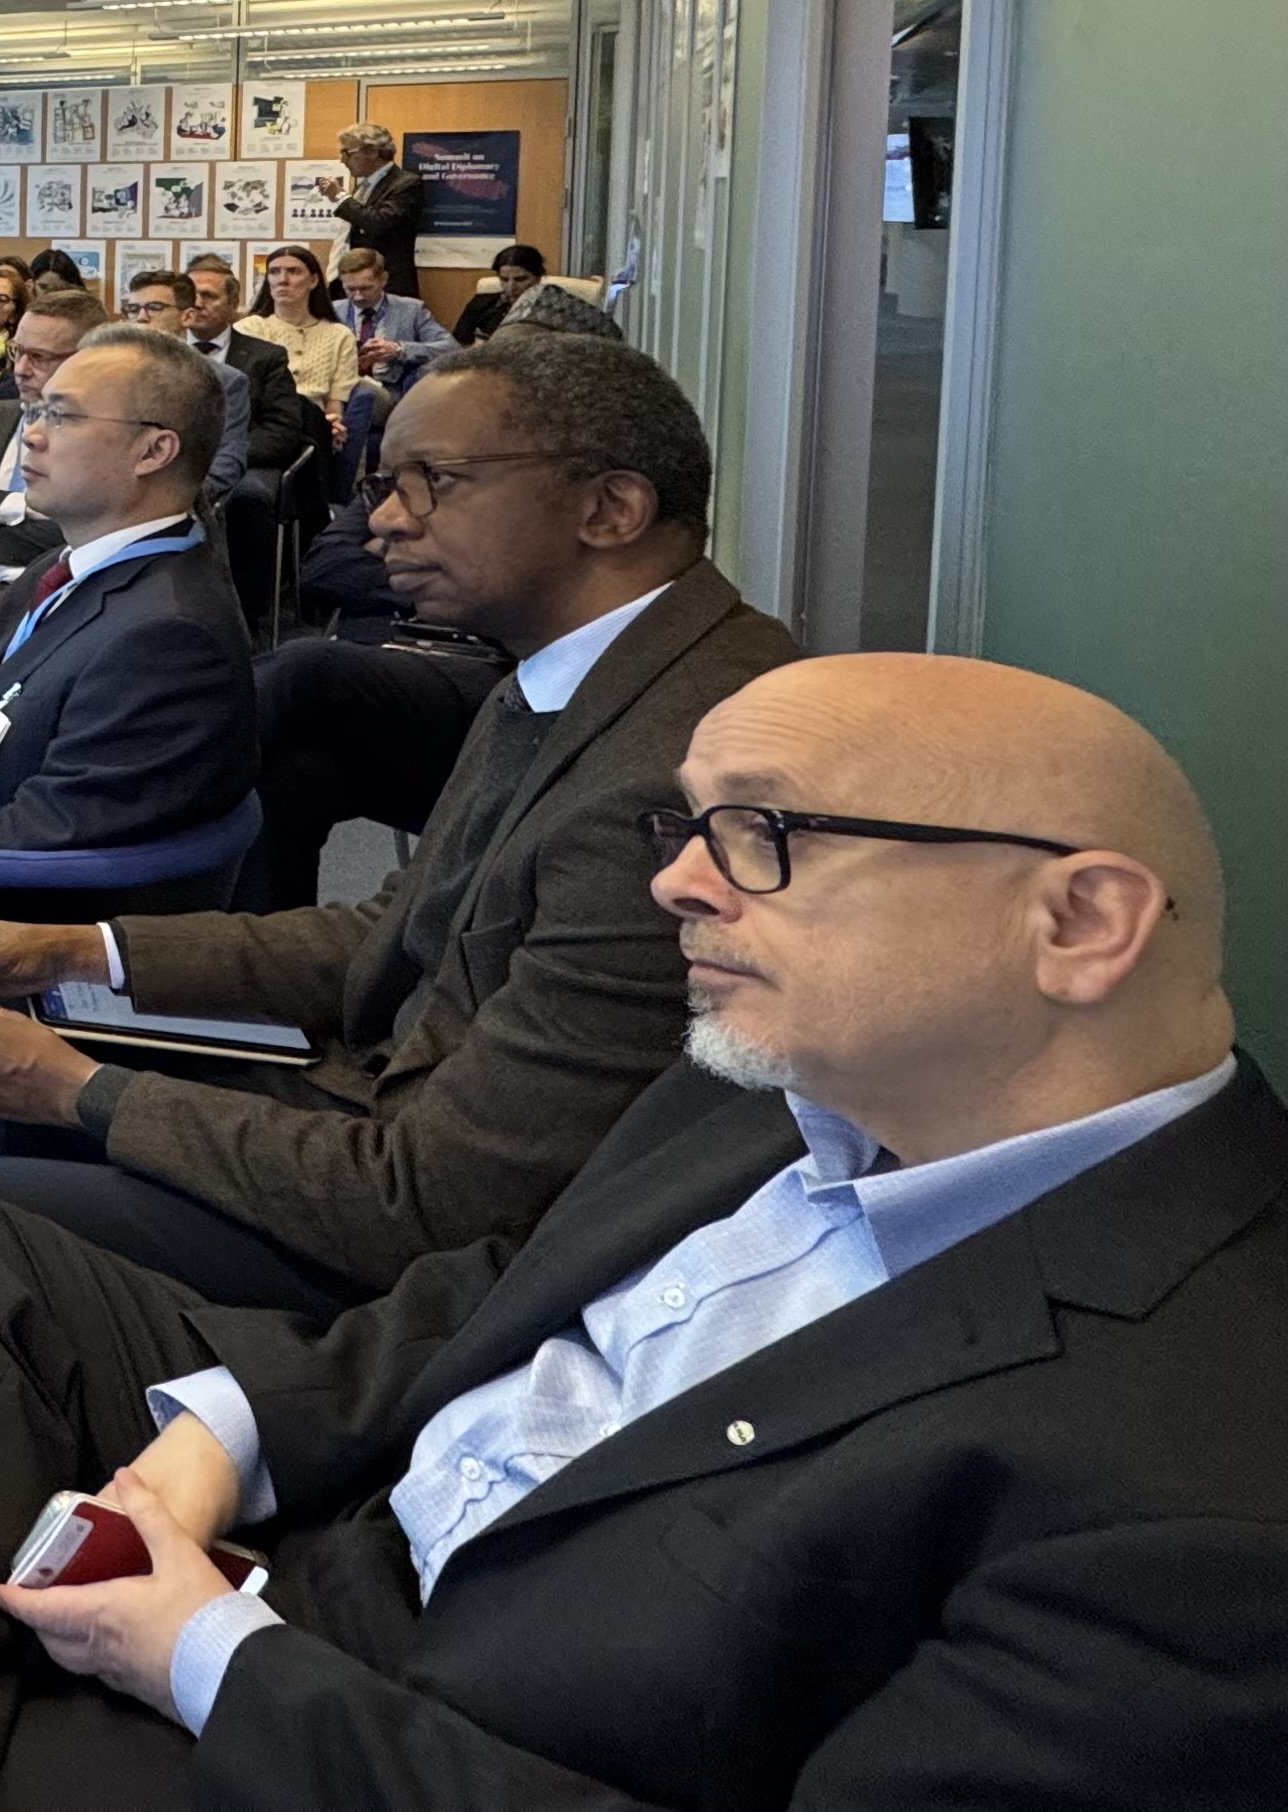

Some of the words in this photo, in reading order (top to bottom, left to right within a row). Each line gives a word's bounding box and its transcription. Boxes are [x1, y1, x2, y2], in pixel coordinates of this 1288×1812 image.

[418, 162, 450, 171] Digital
[451, 161, 500, 172] Diplomacy
[422, 172, 440, 180] and
